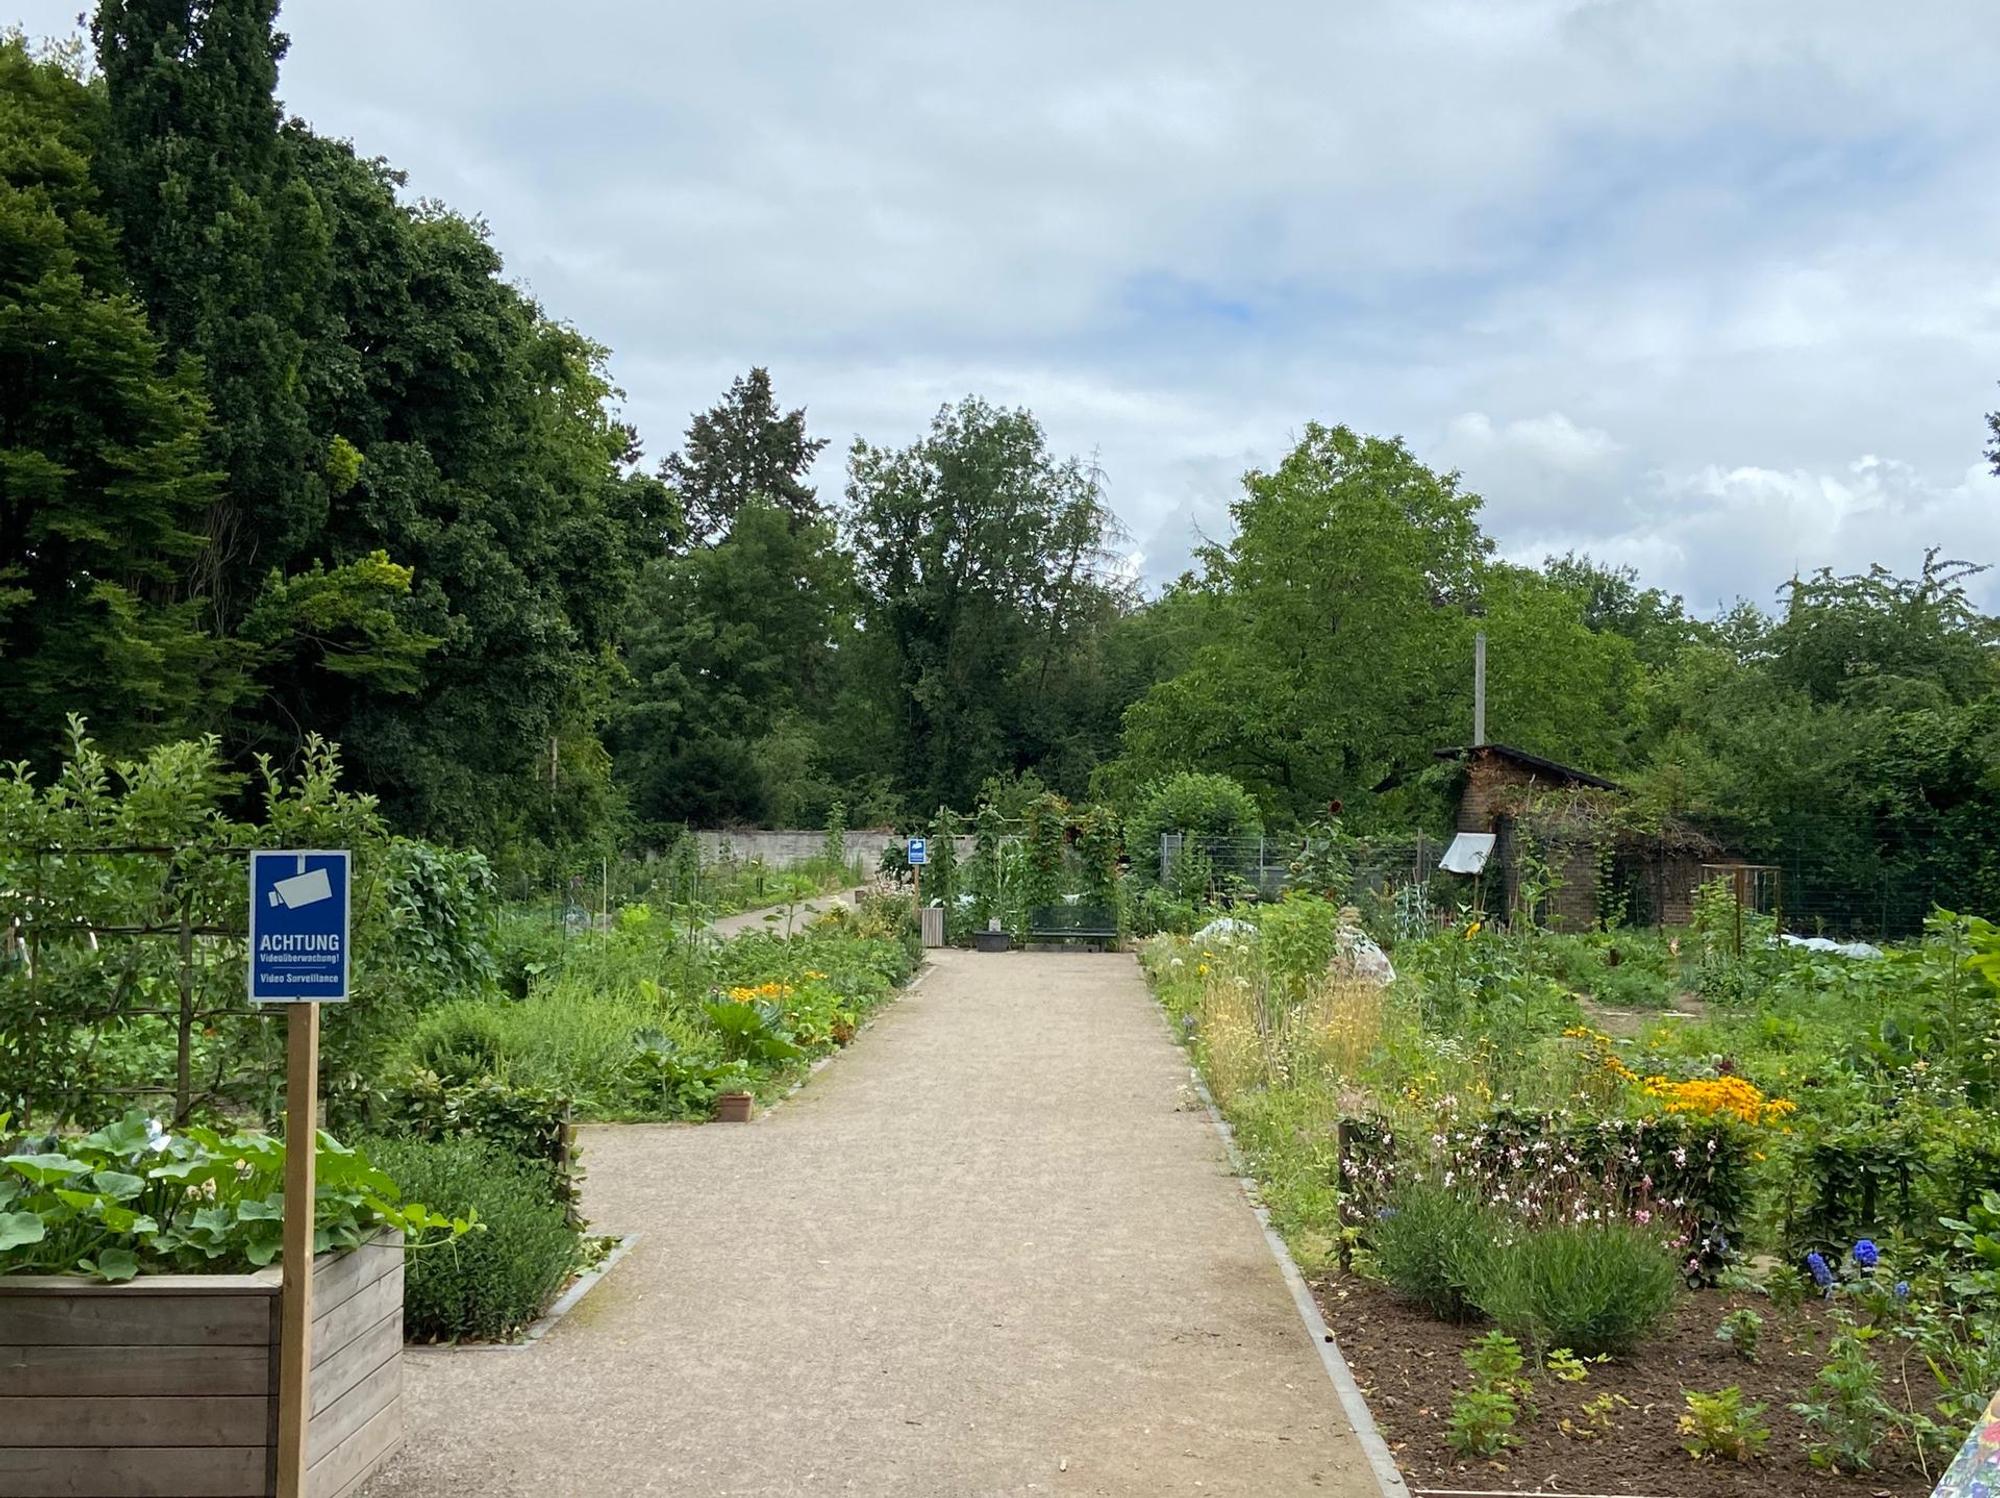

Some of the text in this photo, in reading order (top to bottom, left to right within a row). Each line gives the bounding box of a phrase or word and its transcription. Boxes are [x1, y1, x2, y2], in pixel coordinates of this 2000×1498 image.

[259, 934, 339, 951] ACHTUNG
[260, 953, 340, 964] Videoüberwachung!
[260, 973, 339, 983] Video Surveillance
